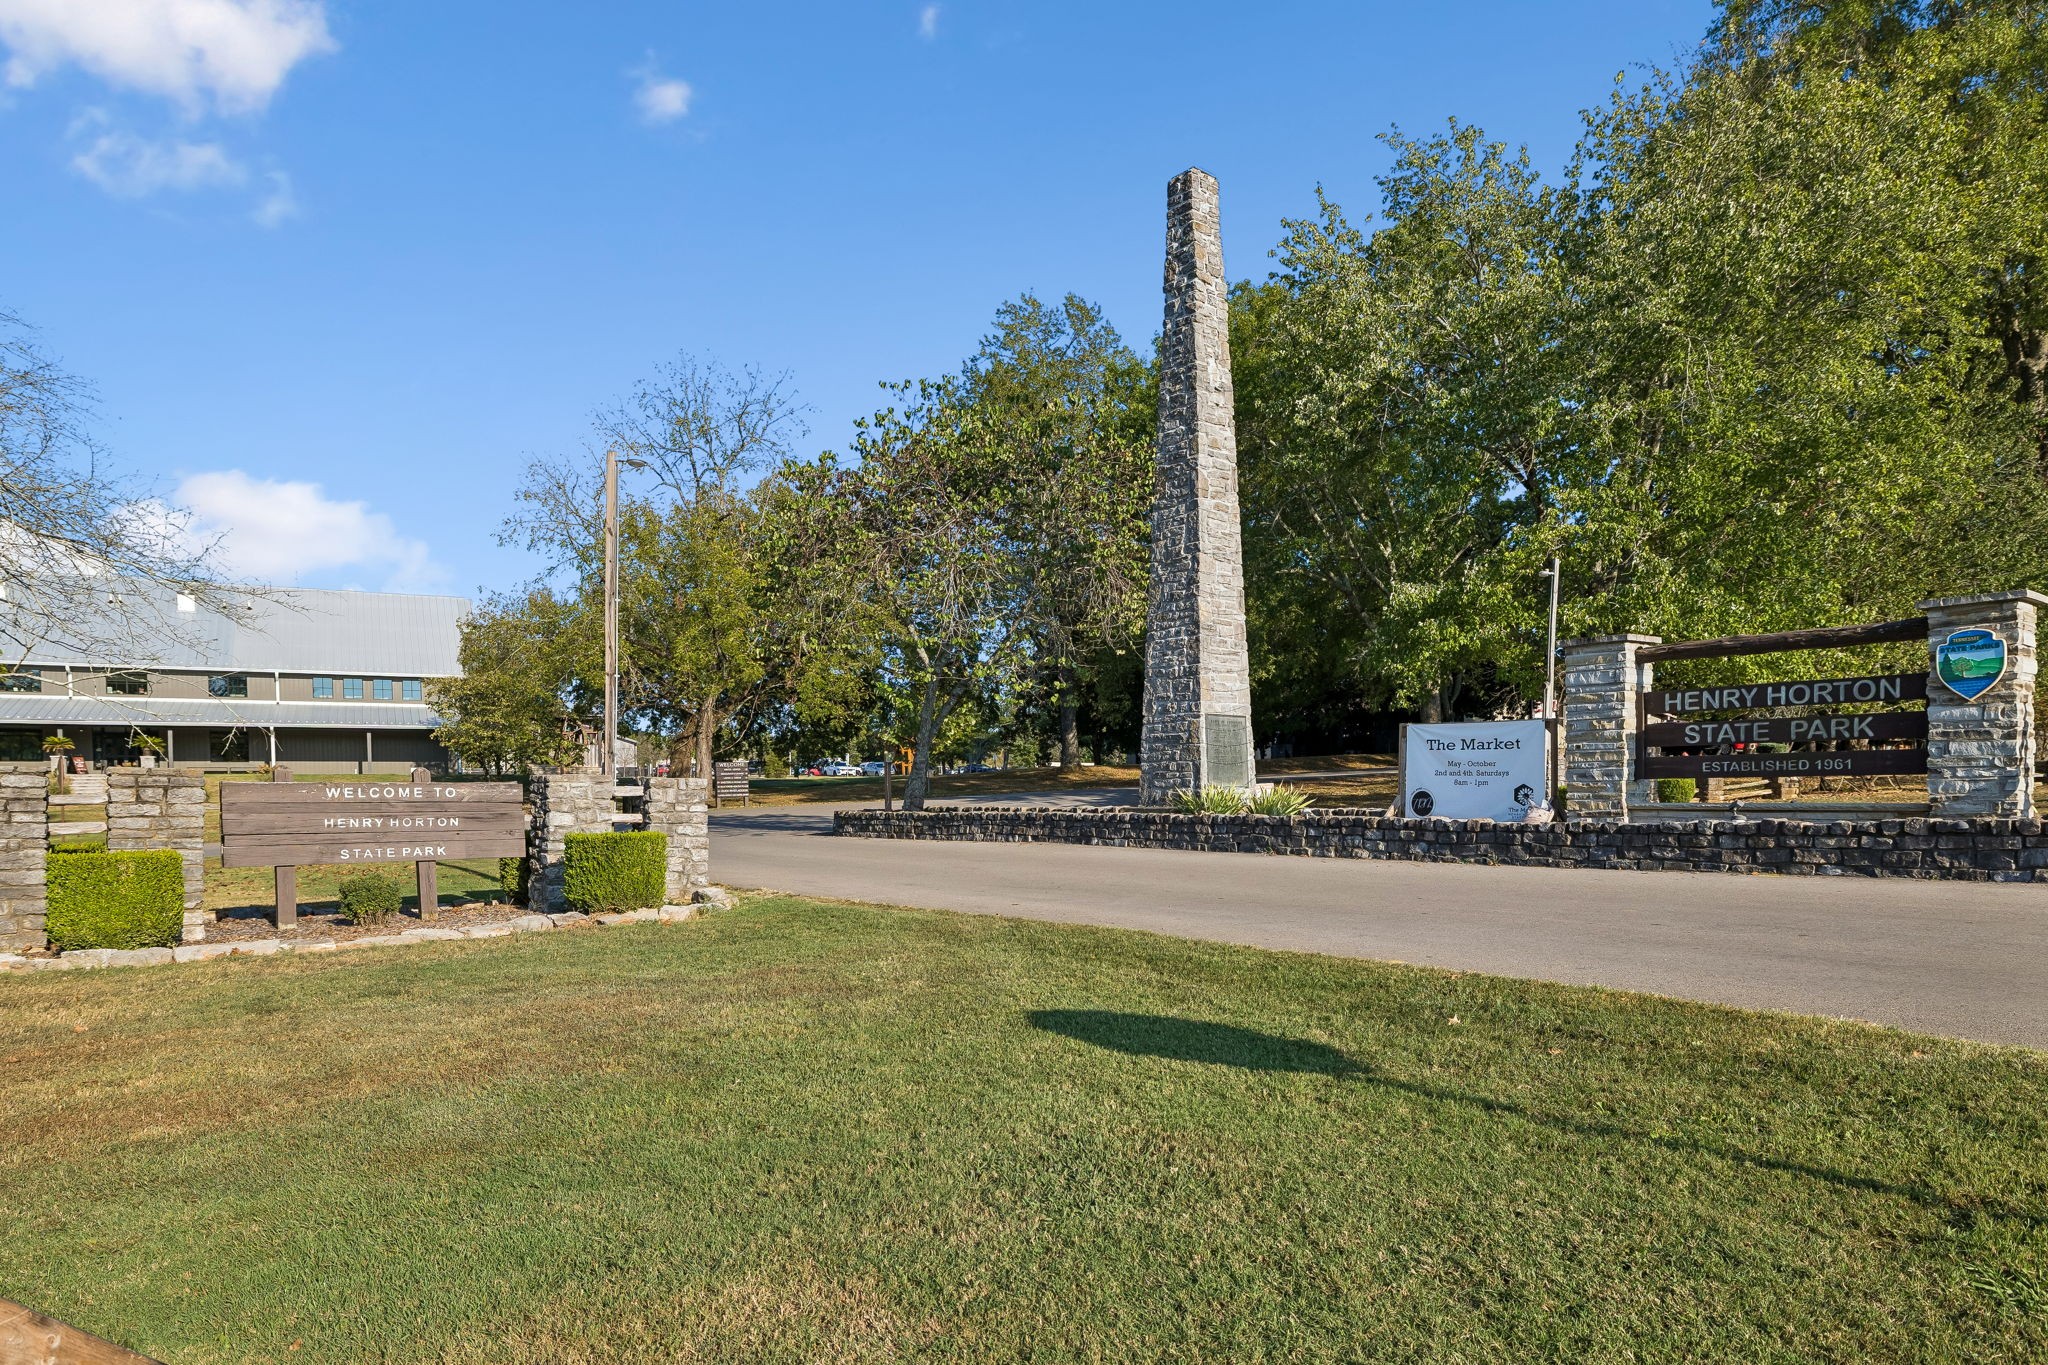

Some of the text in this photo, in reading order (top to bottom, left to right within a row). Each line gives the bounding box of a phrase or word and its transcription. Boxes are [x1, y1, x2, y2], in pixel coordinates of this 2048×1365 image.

[1939, 642, 2000, 654] STATE PARKS
[1664, 678, 1901, 712] HENRY HORTON
[1684, 716, 1875, 744] STATE PARK
[1426, 737, 1521, 751] The Market
[1447, 760, 1462, 768] May
[1702, 758, 1852, 773] ESTABLISHED 1961
[1475, 769, 1510, 777] Saturdays
[1474, 779, 1489, 787] 1pm
[326, 787, 456, 798] WELCOME TO
[324, 817, 459, 828] HENRY HORTON
[340, 846, 446, 859] STATE PARK
